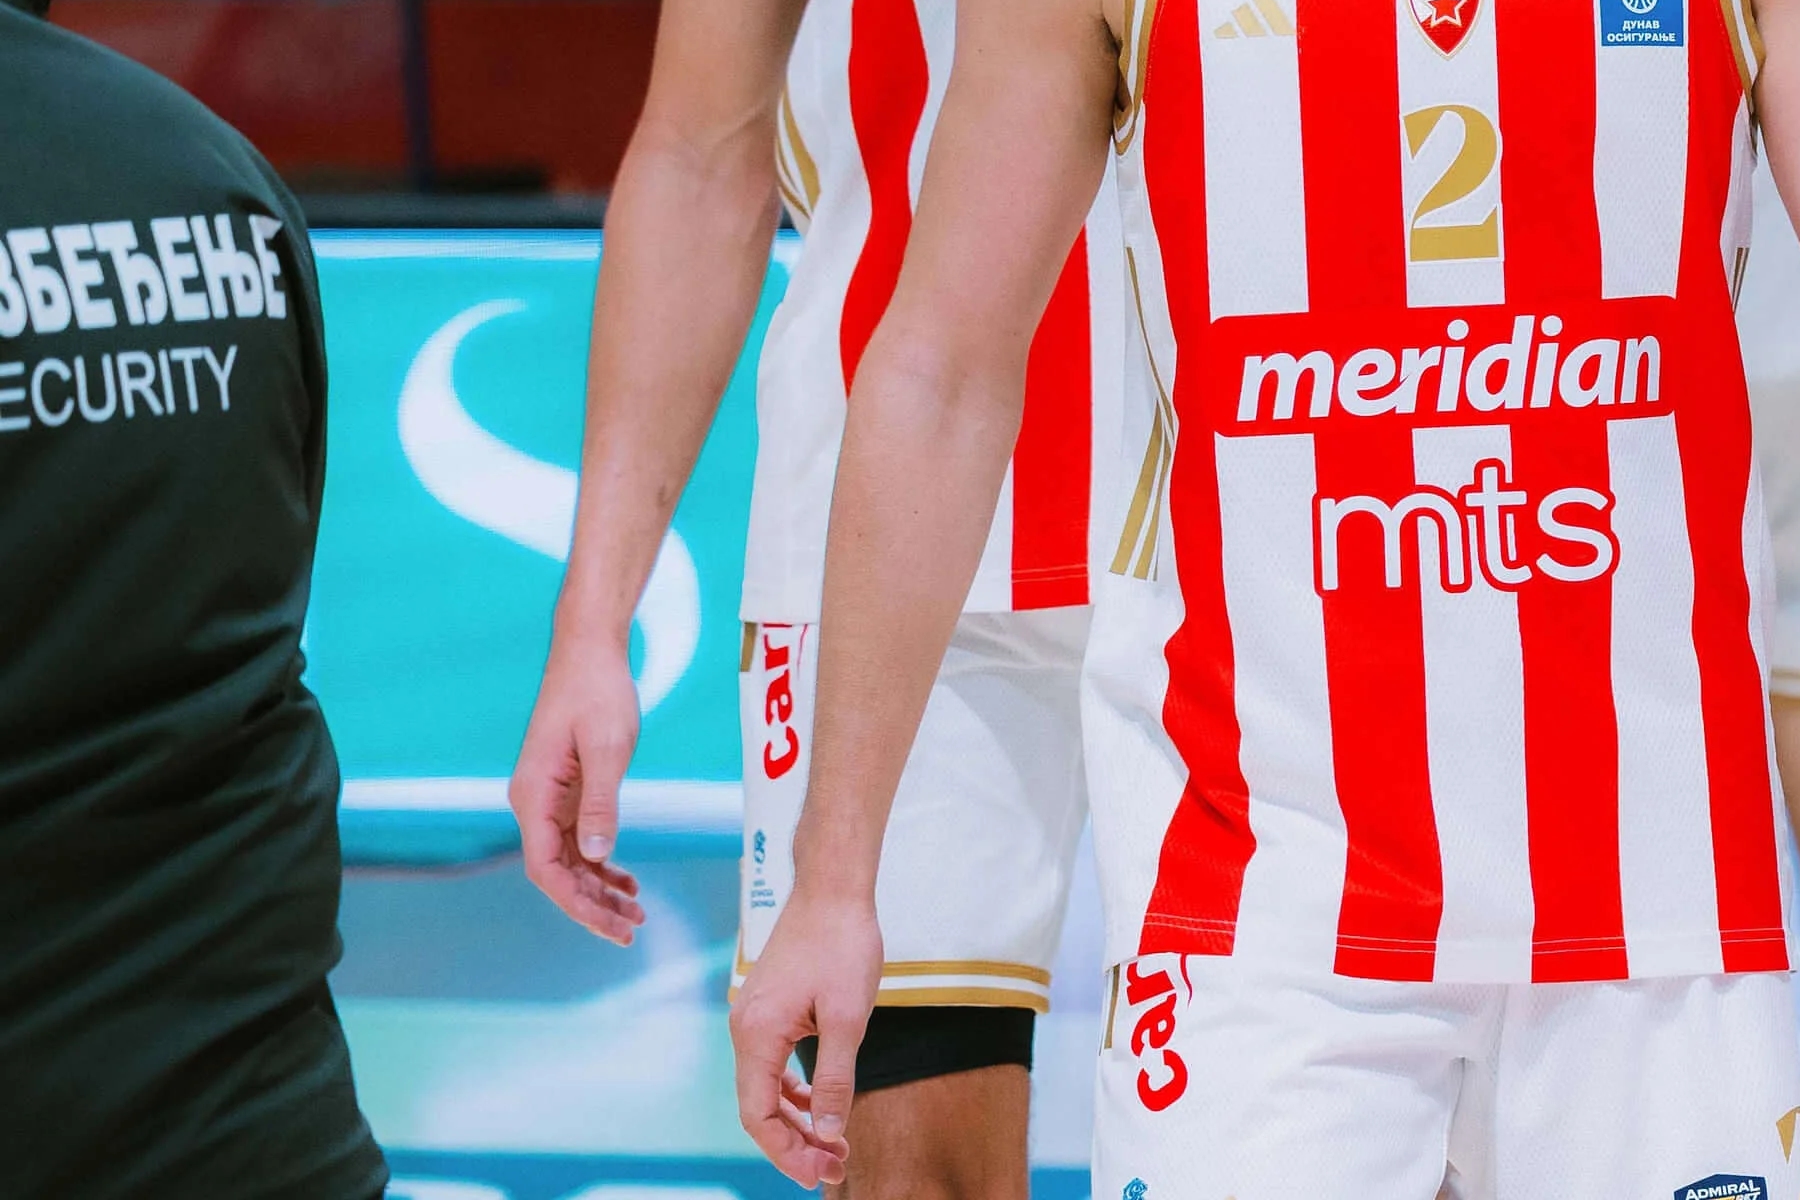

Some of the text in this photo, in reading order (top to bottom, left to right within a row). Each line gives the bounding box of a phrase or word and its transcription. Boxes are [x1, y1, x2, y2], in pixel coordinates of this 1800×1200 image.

[1607, 32, 1677, 43] ОСИГУРАЊЕ
[1622, 20, 1660, 31] ДУНАВ
[1403, 104, 1502, 262] 2
[1236, 315, 1661, 423] meridian
[1320, 466, 1614, 591] mts
[763, 622, 799, 780] car
[1685, 1179, 1761, 1200] ADMIRAL
